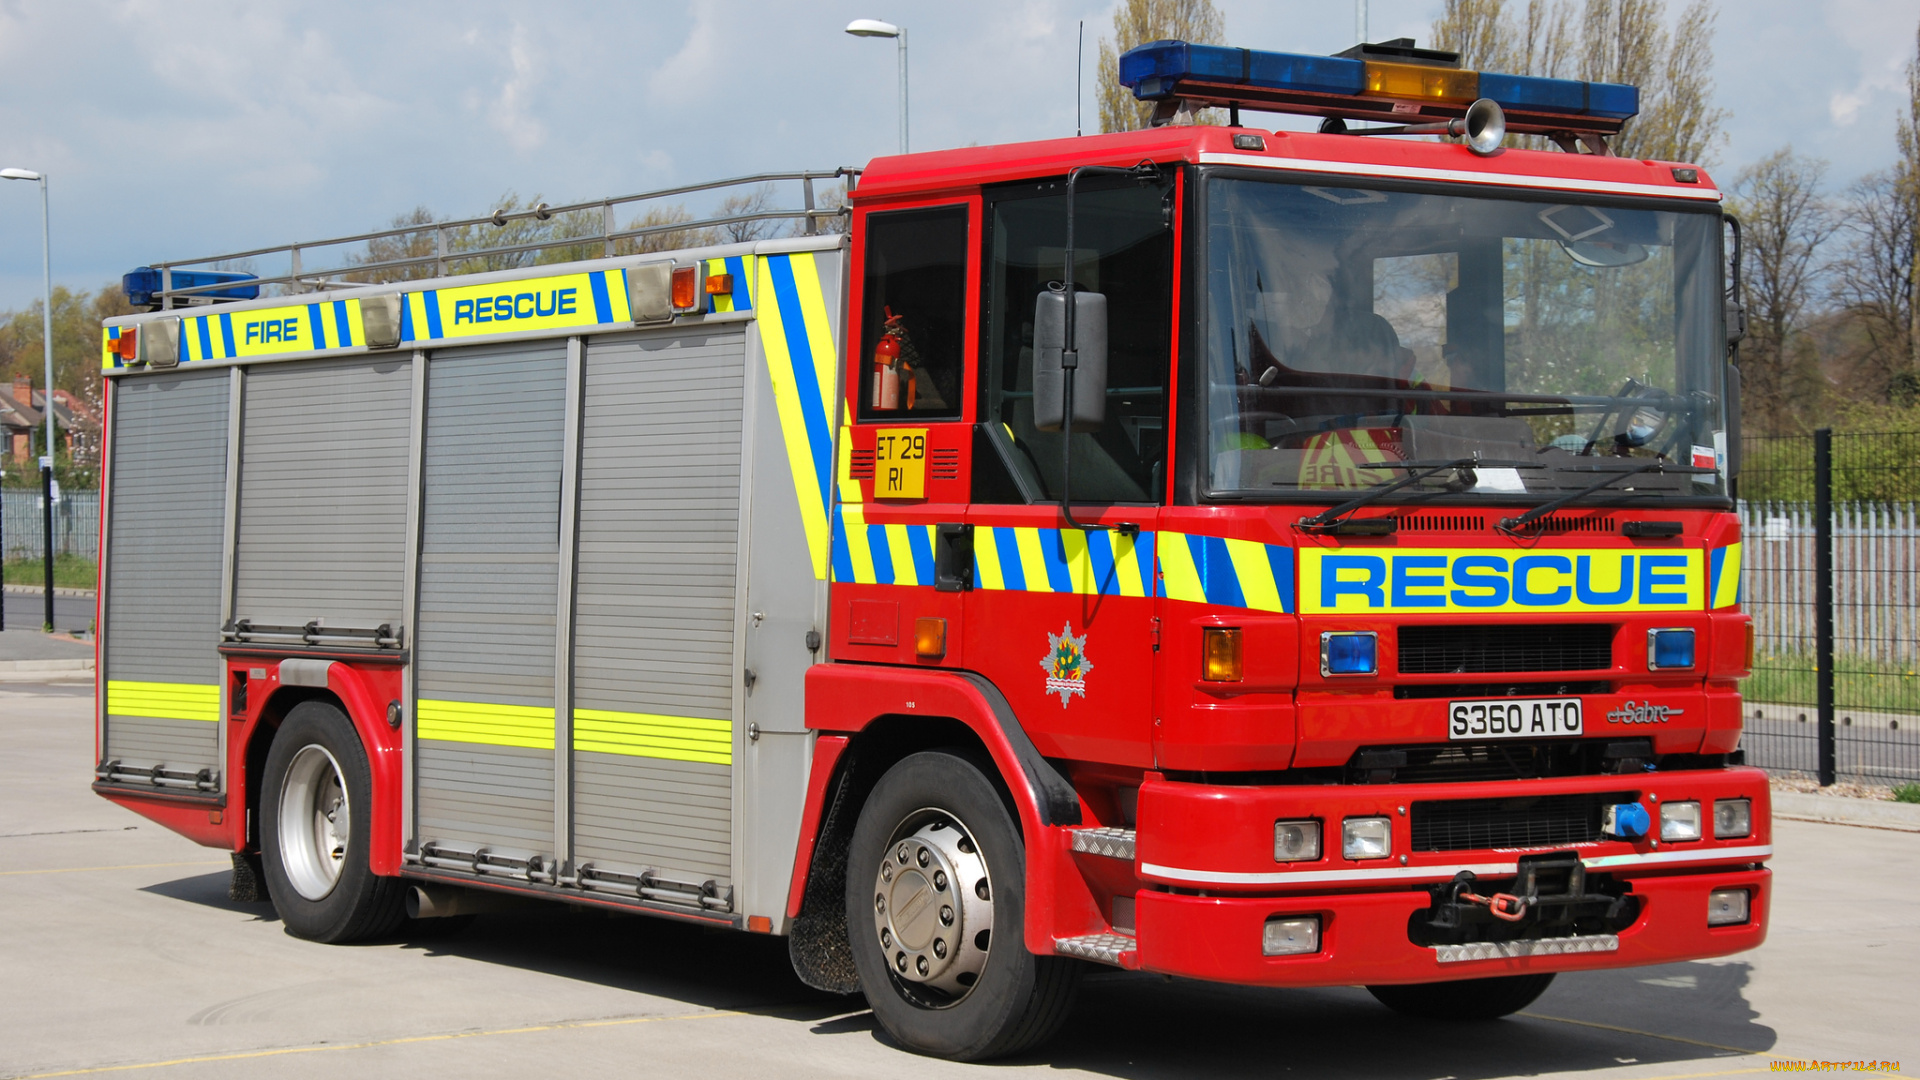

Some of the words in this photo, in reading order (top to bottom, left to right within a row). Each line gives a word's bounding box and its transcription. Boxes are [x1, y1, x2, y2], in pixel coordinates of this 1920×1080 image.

[454, 288, 577, 325] RESCUE
[245, 317, 298, 345] FIRE
[876, 436, 896, 460] ET
[901, 435, 925, 460] 29
[1320, 554, 1688, 608] RESCUE
[1453, 704, 1522, 735] S360
[1531, 702, 1580, 732] ATO
[1622, 700, 1670, 724] Sabre
